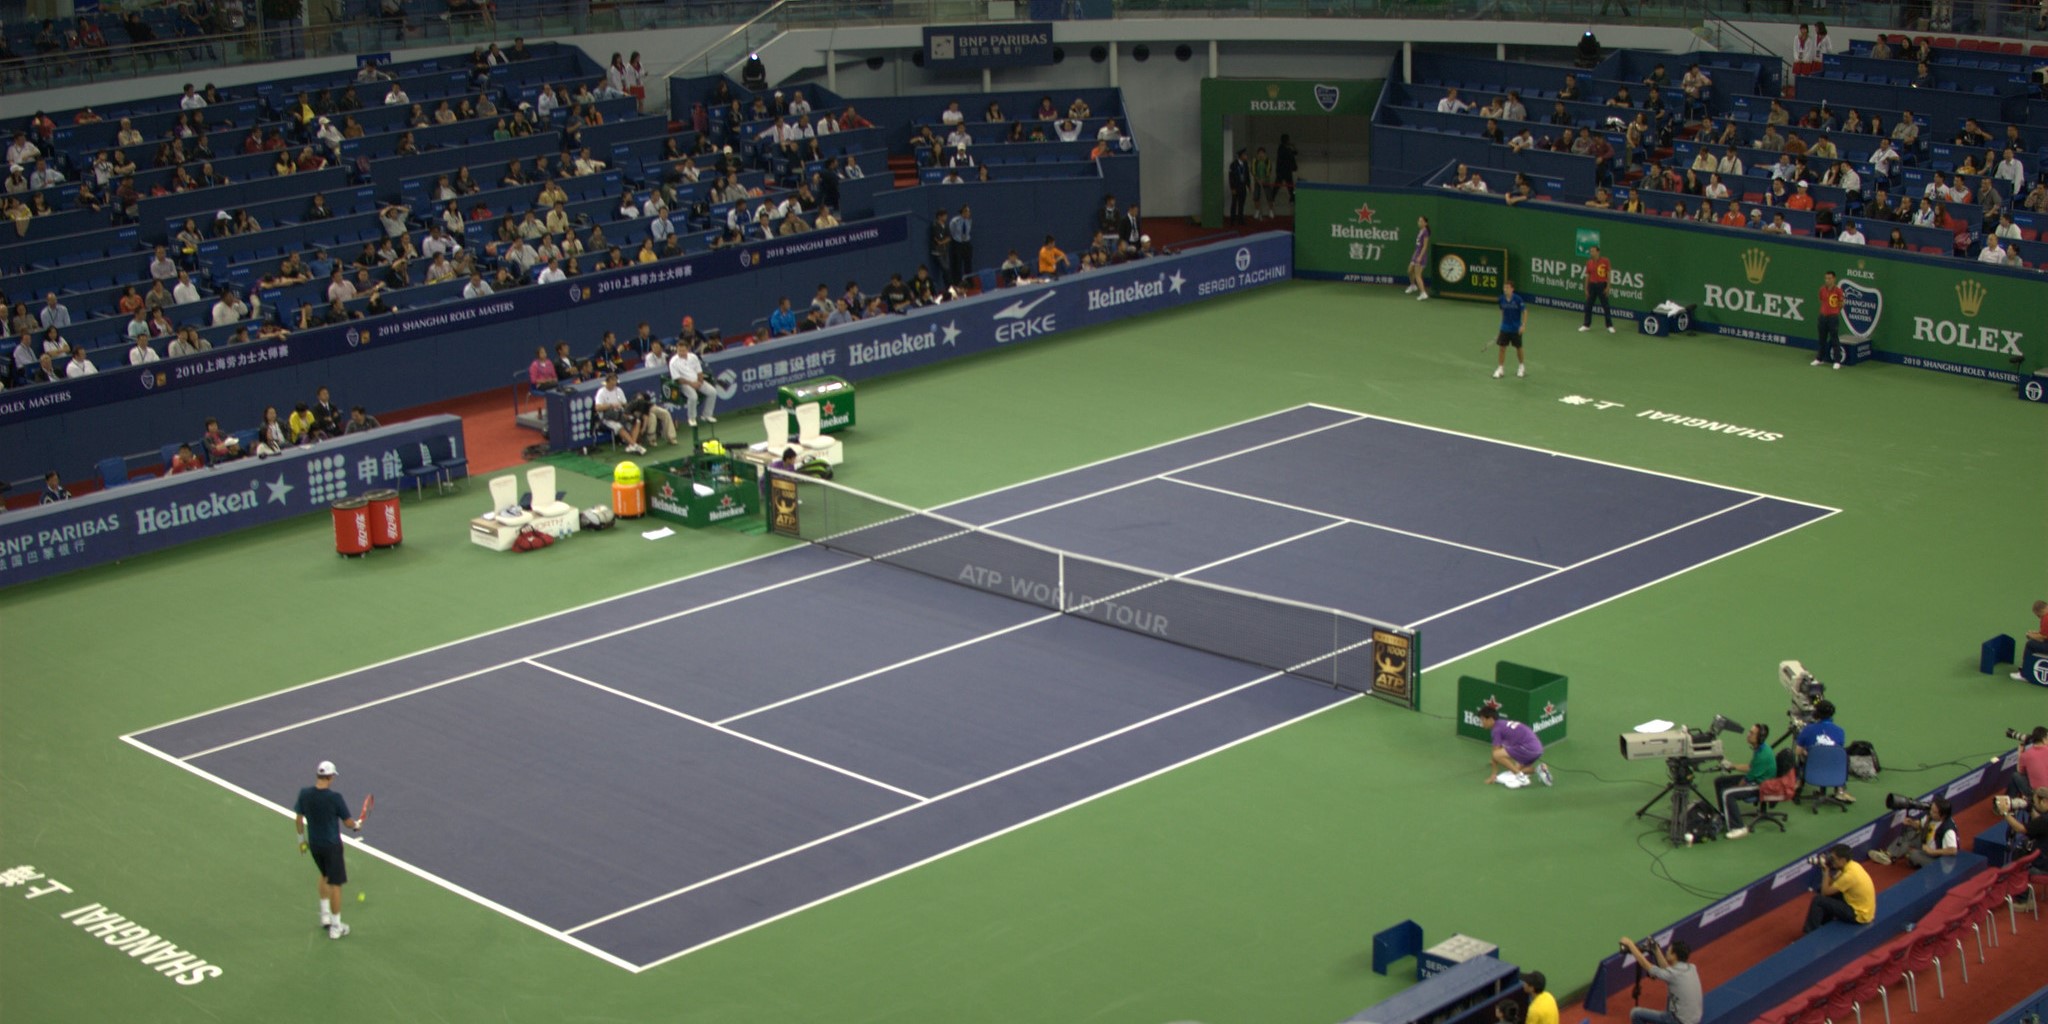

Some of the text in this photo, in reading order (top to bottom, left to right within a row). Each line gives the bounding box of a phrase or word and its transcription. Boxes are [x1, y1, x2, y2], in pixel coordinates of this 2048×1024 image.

[959, 33, 1048, 47] BNP PARIBAS
[1250, 100, 1297, 111] ROLEX
[786, 240, 824, 255] SHANGHAI
[825, 235, 848, 248] ROLEX
[849, 229, 879, 242] MASTERS
[1331, 224, 1399, 241] Heineken
[1349, 242, 1382, 260] 喜力
[1198, 264, 1286, 296] SERGIO TACCHINI
[1470, 264, 1499, 275] ROLEX
[1531, 257, 1645, 289] BNP PABAS
[1846, 268, 1875, 280] ROLEX
[1088, 278, 1164, 311] Heineken
[1531, 273, 1546, 285] The
[1546, 275, 1565, 288] bank
[1565, 279, 1578, 291] for
[1620, 289, 1643, 300] world
[1551, 299, 1585, 311] SHANGHAI
[1703, 284, 1804, 321] ROLEX
[378, 301, 515, 337] 2010 SHANGHAI ROLEX MASTERS
[995, 313, 1056, 343] ERKE
[849, 331, 936, 367] Heineken
[1913, 316, 2024, 356] ROLEX
[741, 348, 837, 383] 中国建设银行
[1903, 356, 2020, 383] 2010 SHANGHAI ROLEX MASTERS
[29, 390, 73, 410] MASTERS
[819, 413, 850, 429] ineken
[1635, 408, 1784, 442] SHANGHAI
[136, 489, 259, 535] Heineken
[652, 496, 689, 518] Heineken
[709, 504, 746, 522] Heineken
[776, 513, 796, 527] ATP
[38, 513, 121, 547] PARIBAS
[958, 563, 1169, 636] ATP WORLD TOUR
[1375, 672, 1405, 689] ATP
[1532, 713, 1565, 733] Heineken
[60, 902, 223, 986] SHANGHAI
